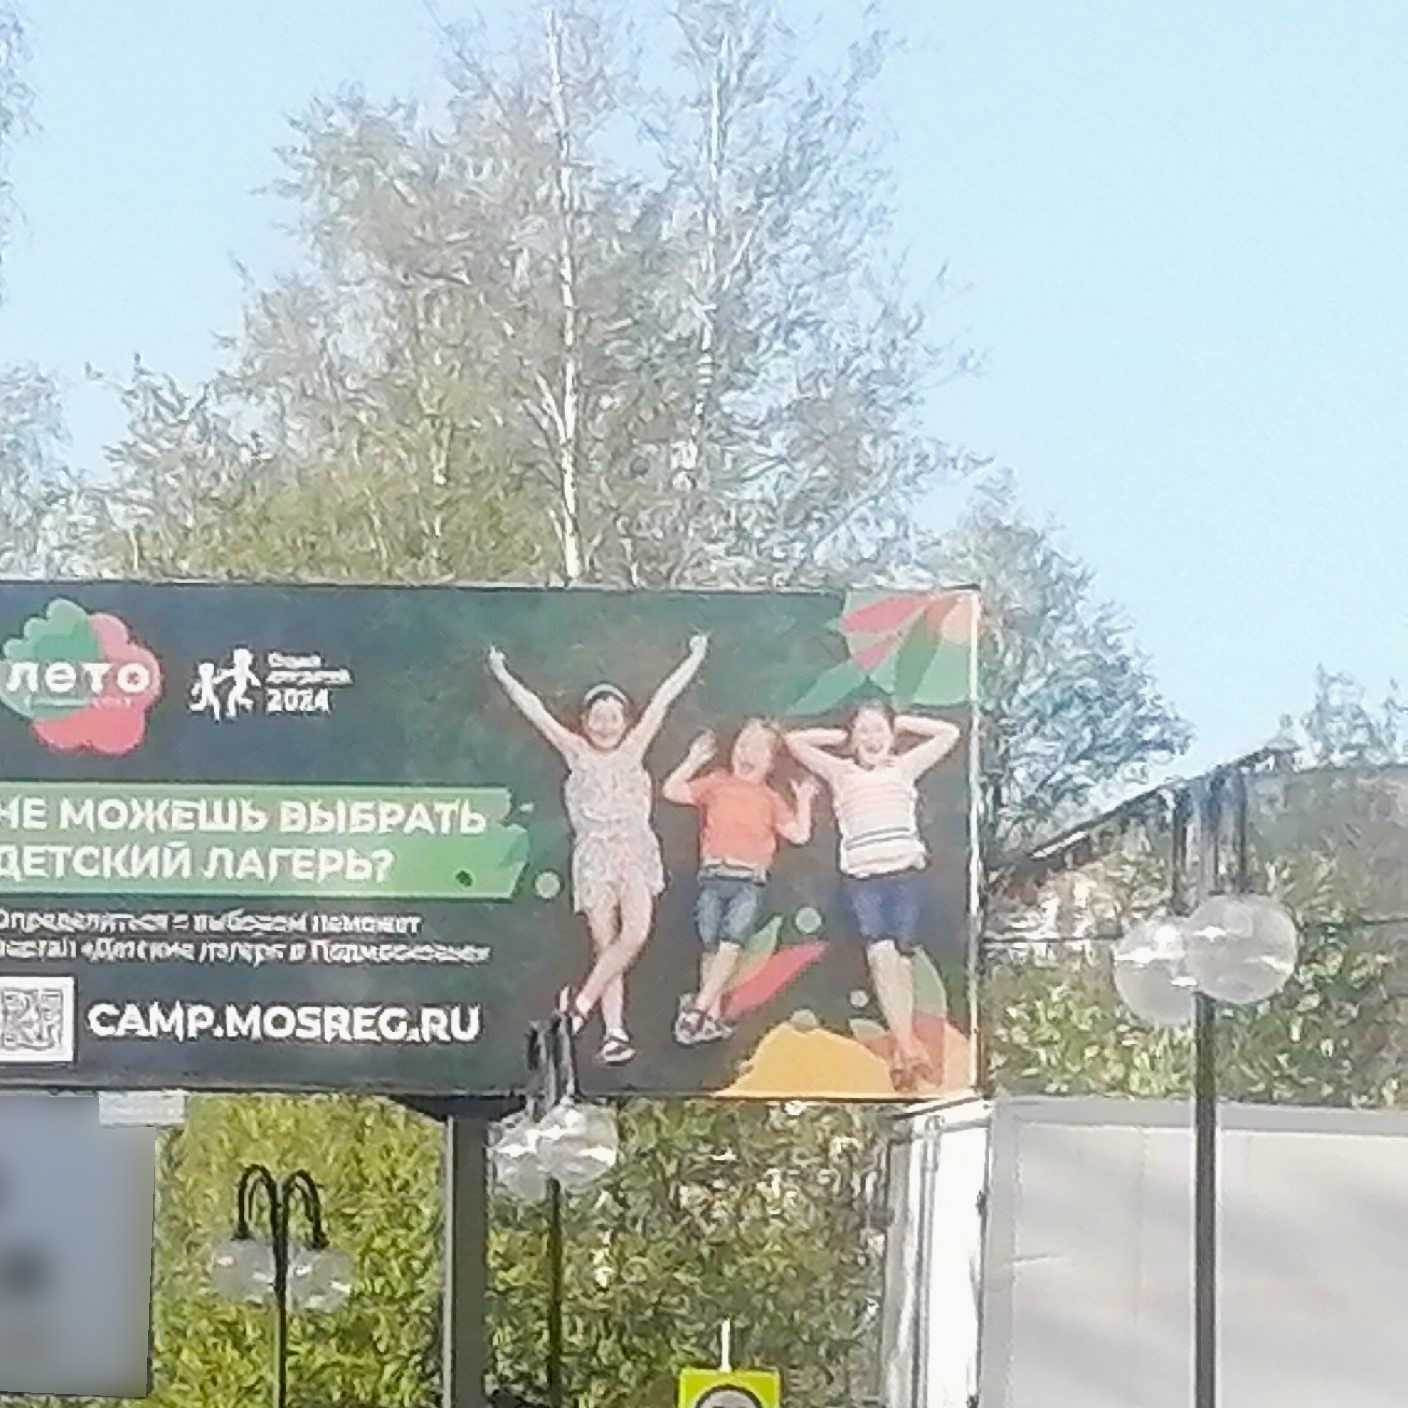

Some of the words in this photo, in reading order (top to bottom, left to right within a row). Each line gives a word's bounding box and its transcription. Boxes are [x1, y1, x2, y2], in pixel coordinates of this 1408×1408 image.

[6, 661, 151, 694] лето
[60, 798, 269, 833] МОЖЕШЬ
[279, 800, 486, 833] ВЫБРАТЬ
[204, 849, 395, 881] ЛАГЕРЬ?
[87, 1002, 481, 1042] CAMP.MOSREG.RU
